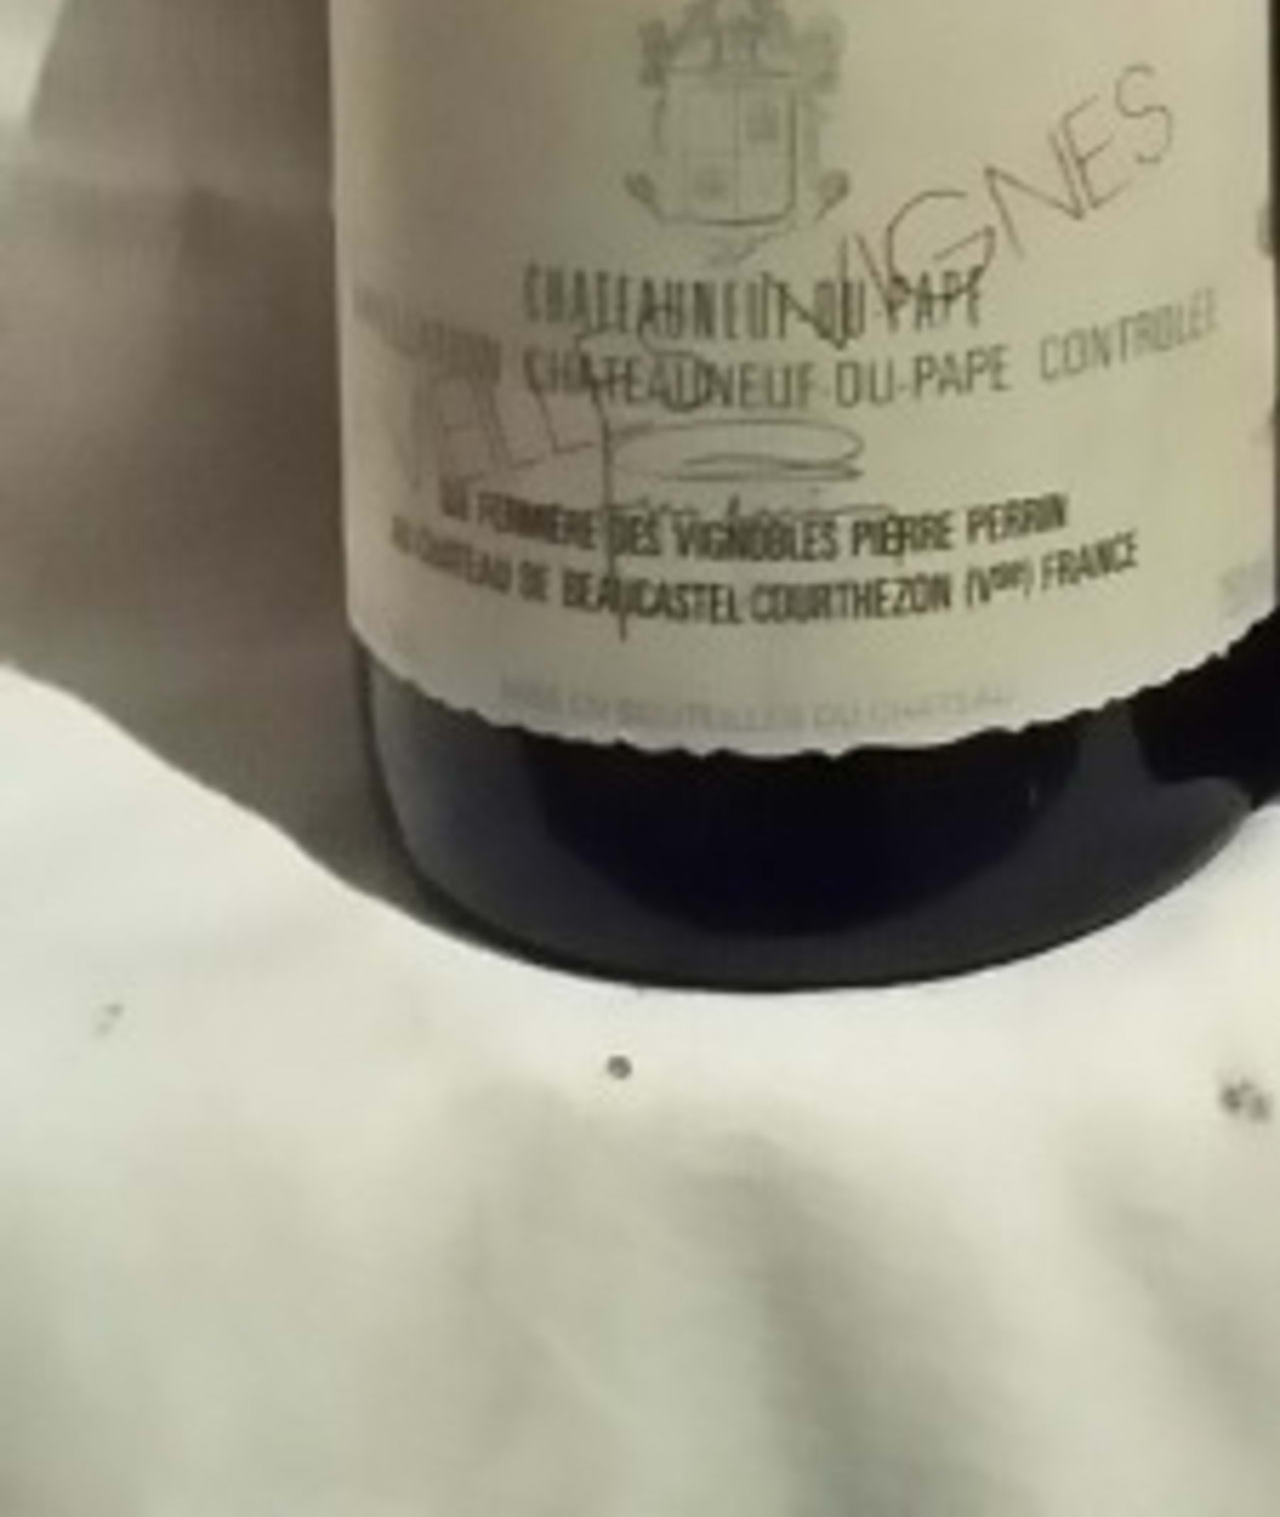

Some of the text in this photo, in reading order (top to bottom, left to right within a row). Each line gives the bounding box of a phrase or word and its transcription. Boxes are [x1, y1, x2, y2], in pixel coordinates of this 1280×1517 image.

[762, 58, 1176, 352] VIGNES
[517, 560, 550, 604] DE
[560, 566, 745, 626] BEAUCASTEL
[750, 570, 952, 626] COURTHEZON
[1040, 524, 1140, 592] FRANCE
[603, 510, 662, 558] DES
[671, 514, 842, 563] VIGNOBLES
[852, 508, 956, 559] PIERRE
[965, 490, 1069, 546] PERRIN
